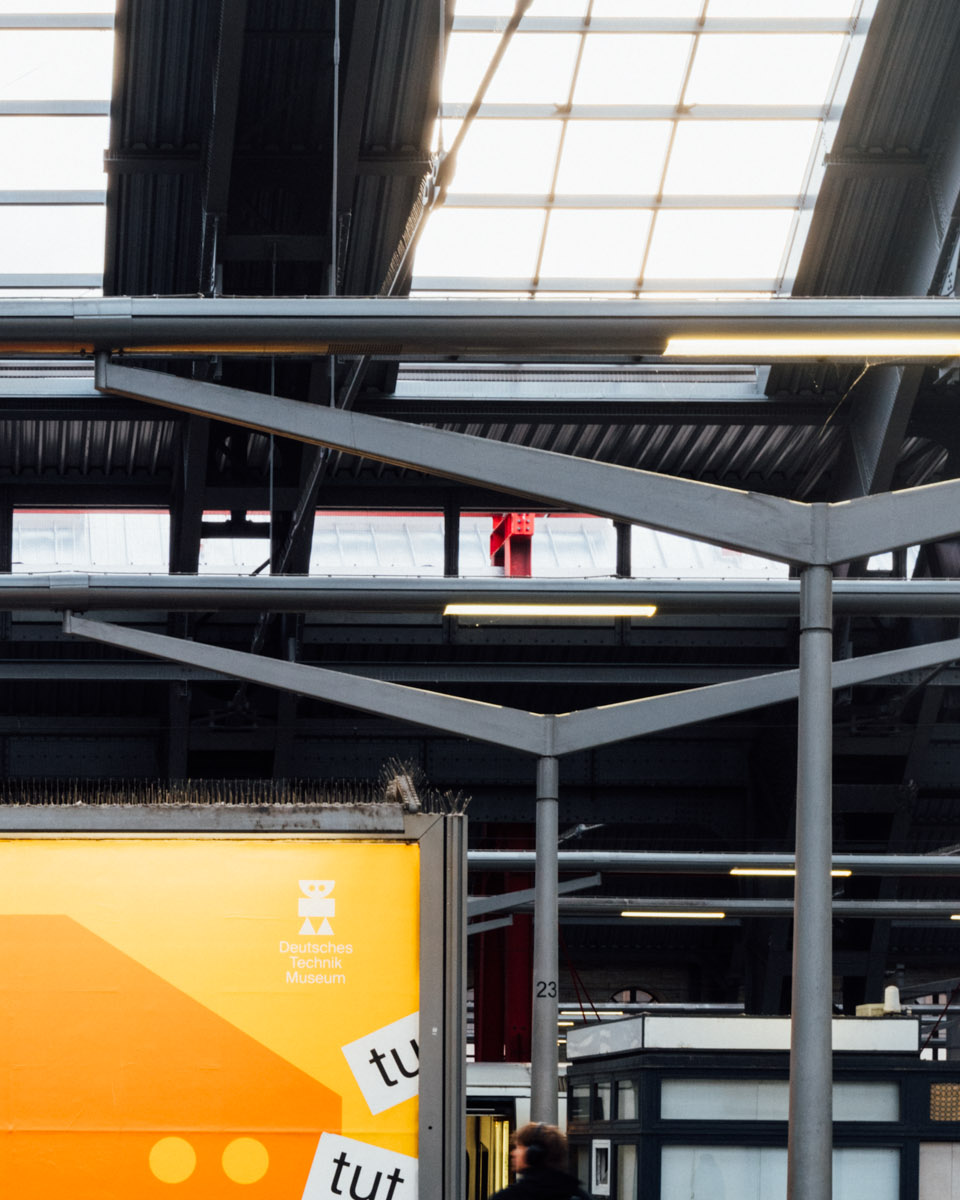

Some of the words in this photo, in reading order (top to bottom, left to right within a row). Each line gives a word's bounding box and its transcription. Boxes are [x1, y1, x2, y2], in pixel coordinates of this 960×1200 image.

[279, 940, 353, 954] Deutsches
[289, 956, 343, 969] Technik
[285, 971, 346, 984] Museum
[536, 981, 557, 998] 23
